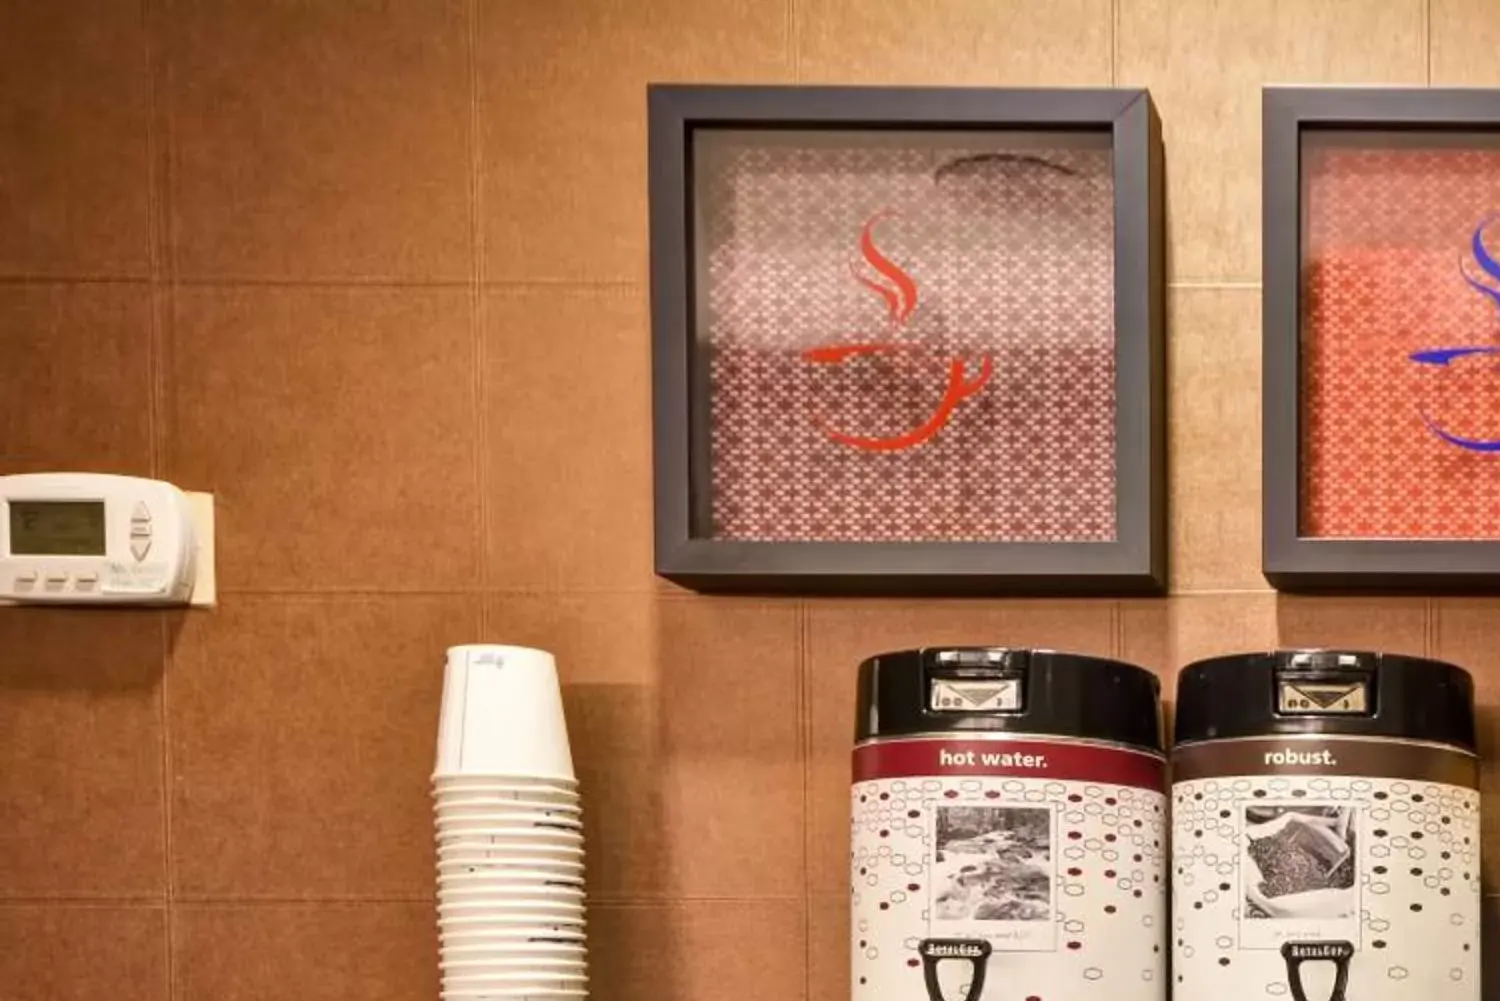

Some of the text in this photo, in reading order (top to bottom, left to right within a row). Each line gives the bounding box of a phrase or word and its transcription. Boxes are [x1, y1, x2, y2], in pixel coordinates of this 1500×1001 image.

[940, 748, 1049, 769] hot water.
[1264, 747, 1338, 766] robust.
